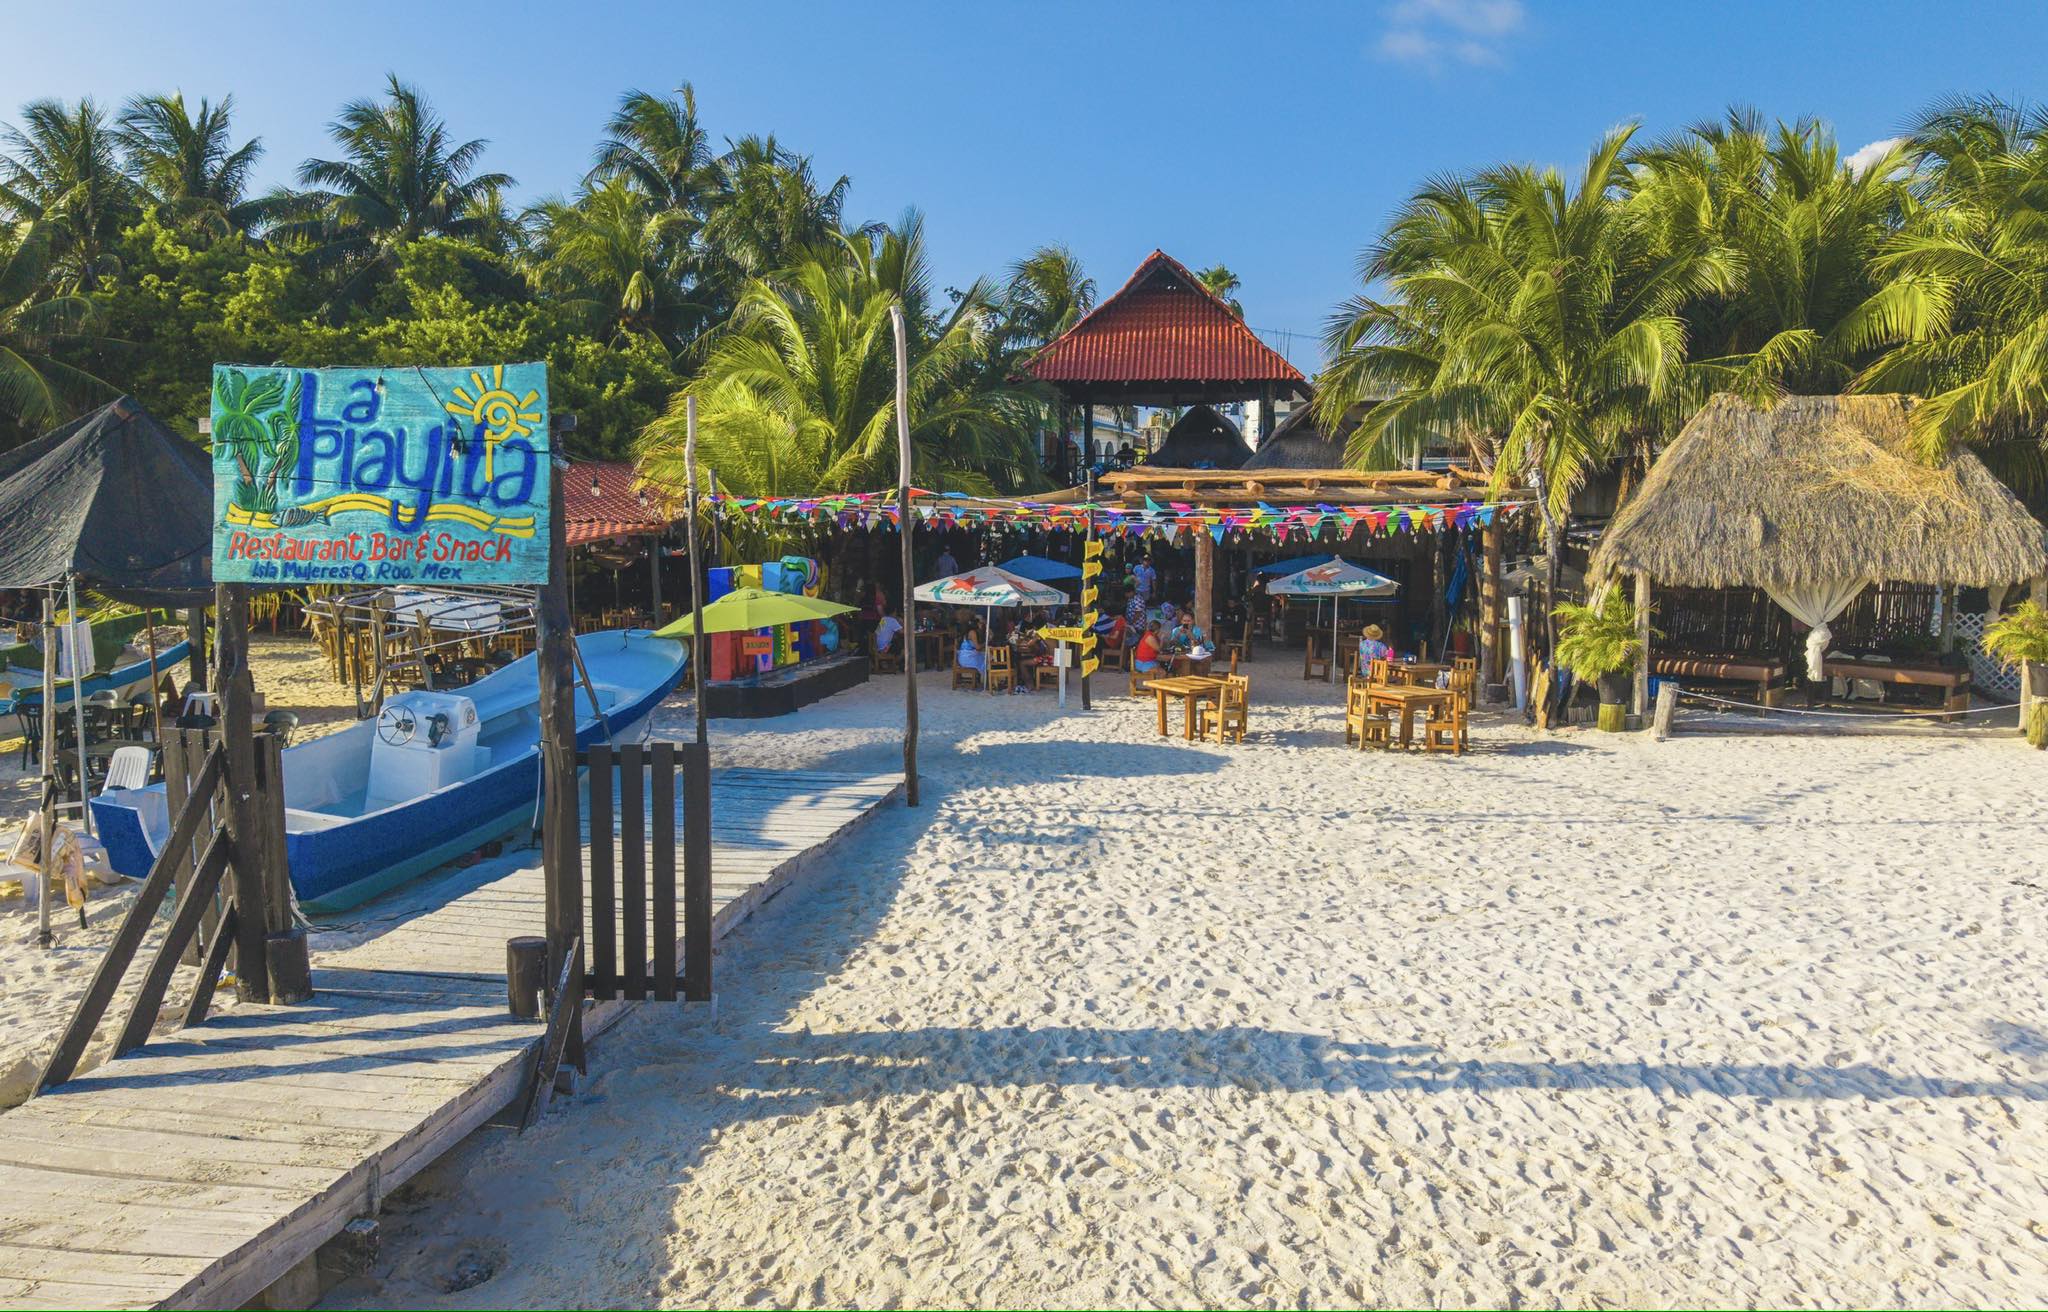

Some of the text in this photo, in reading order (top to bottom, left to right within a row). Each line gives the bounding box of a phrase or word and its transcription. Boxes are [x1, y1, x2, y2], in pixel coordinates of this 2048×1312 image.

[302, 372, 379, 428] La
[295, 415, 538, 533] Playita
[228, 531, 363, 561] Restaurant
[368, 532, 414, 561] Bar
[432, 533, 513, 563] Snack
[252, 561, 279, 579] Isla
[283, 562, 351, 580] Mujeres
[421, 562, 462, 580] Mex
